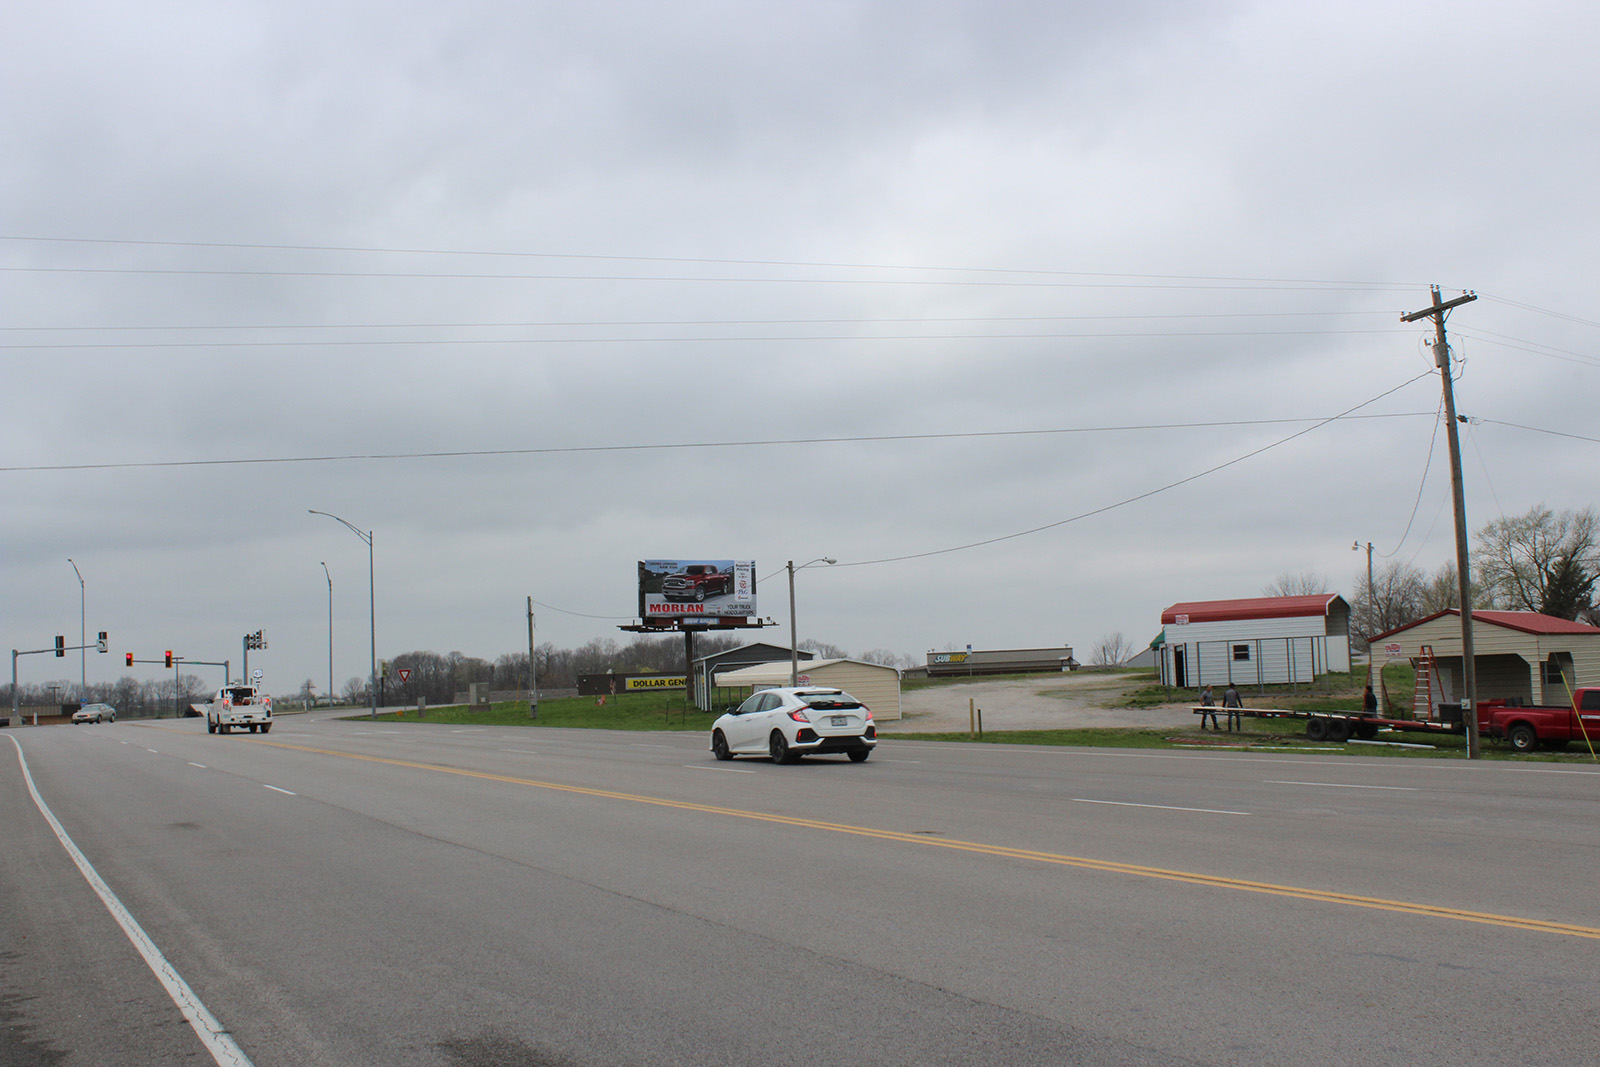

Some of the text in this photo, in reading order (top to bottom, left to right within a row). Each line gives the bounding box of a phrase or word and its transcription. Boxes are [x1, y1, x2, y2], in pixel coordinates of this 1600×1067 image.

[649, 604, 704, 612] MORLAN
[934, 654, 968, 663] SUBWAY
[668, 678, 687, 686] GEN
